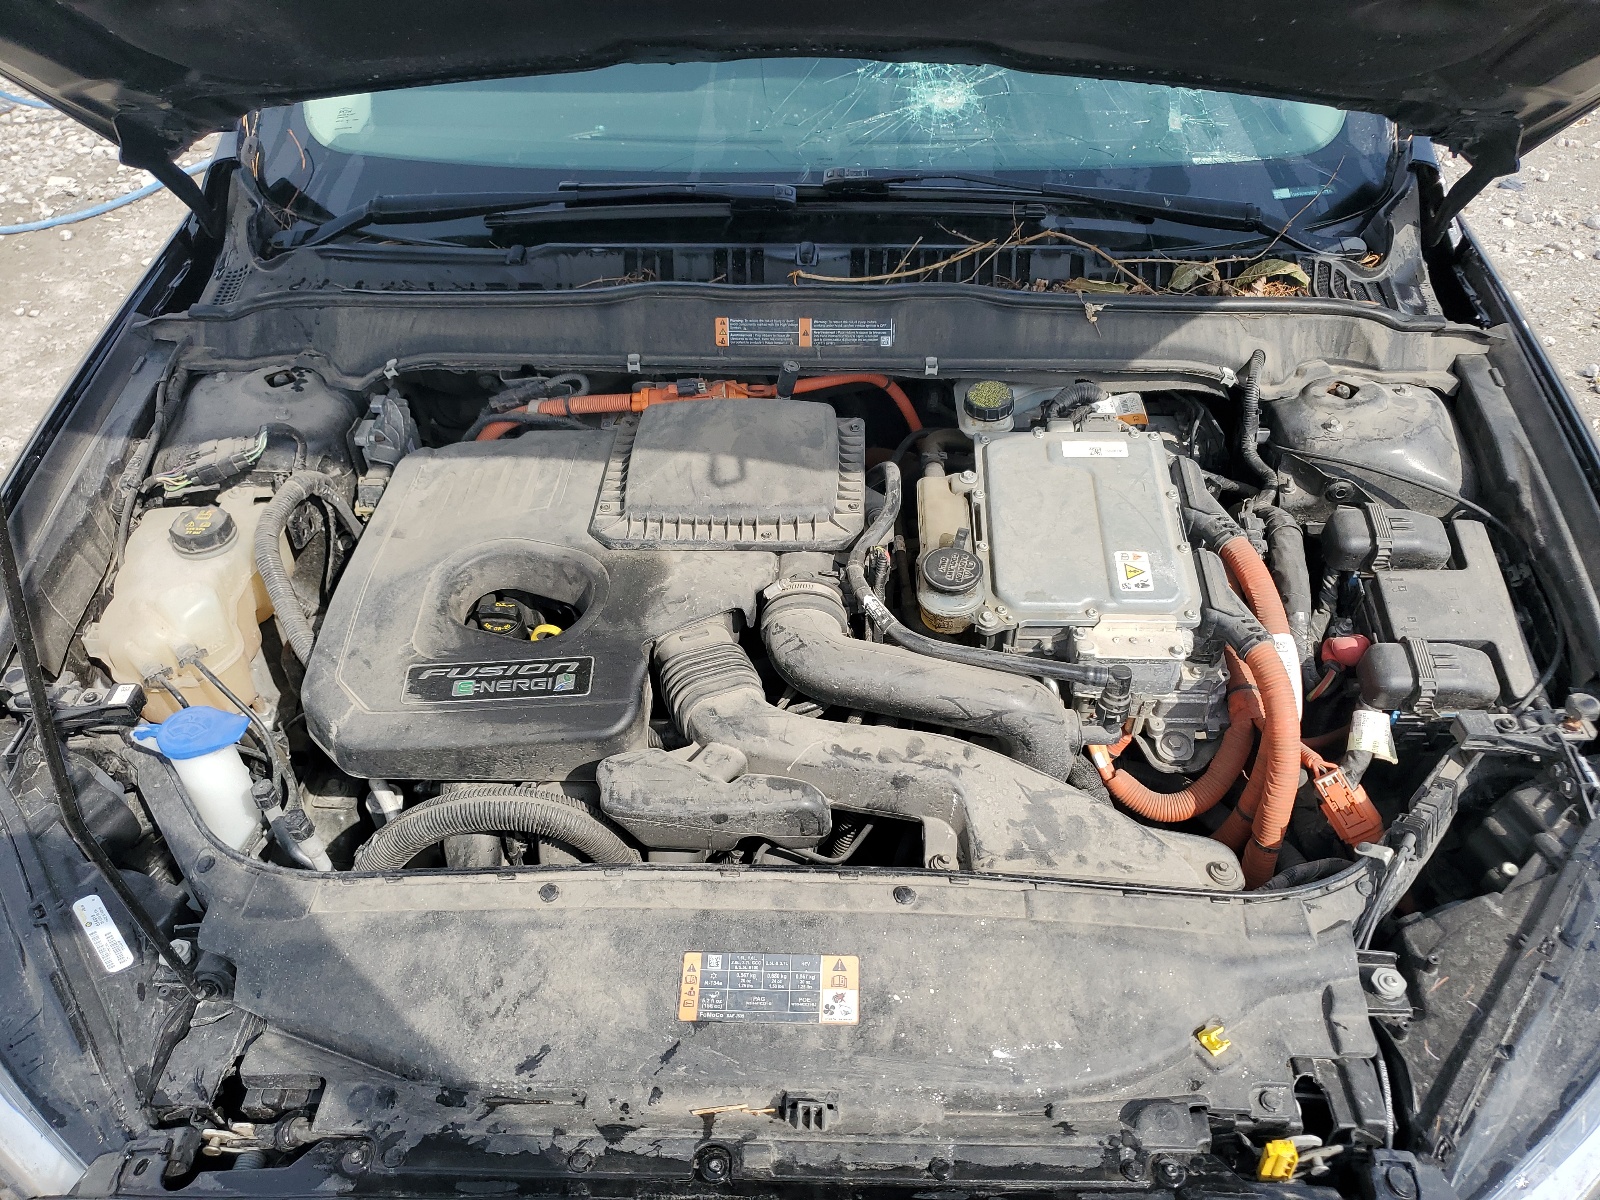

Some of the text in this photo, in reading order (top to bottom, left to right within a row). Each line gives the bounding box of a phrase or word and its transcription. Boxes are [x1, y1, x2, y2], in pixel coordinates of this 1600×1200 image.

[938, 556, 949, 572] ONLY
[418, 662, 580, 680] FUSION
[452, 677, 554, 696] ENERGI
